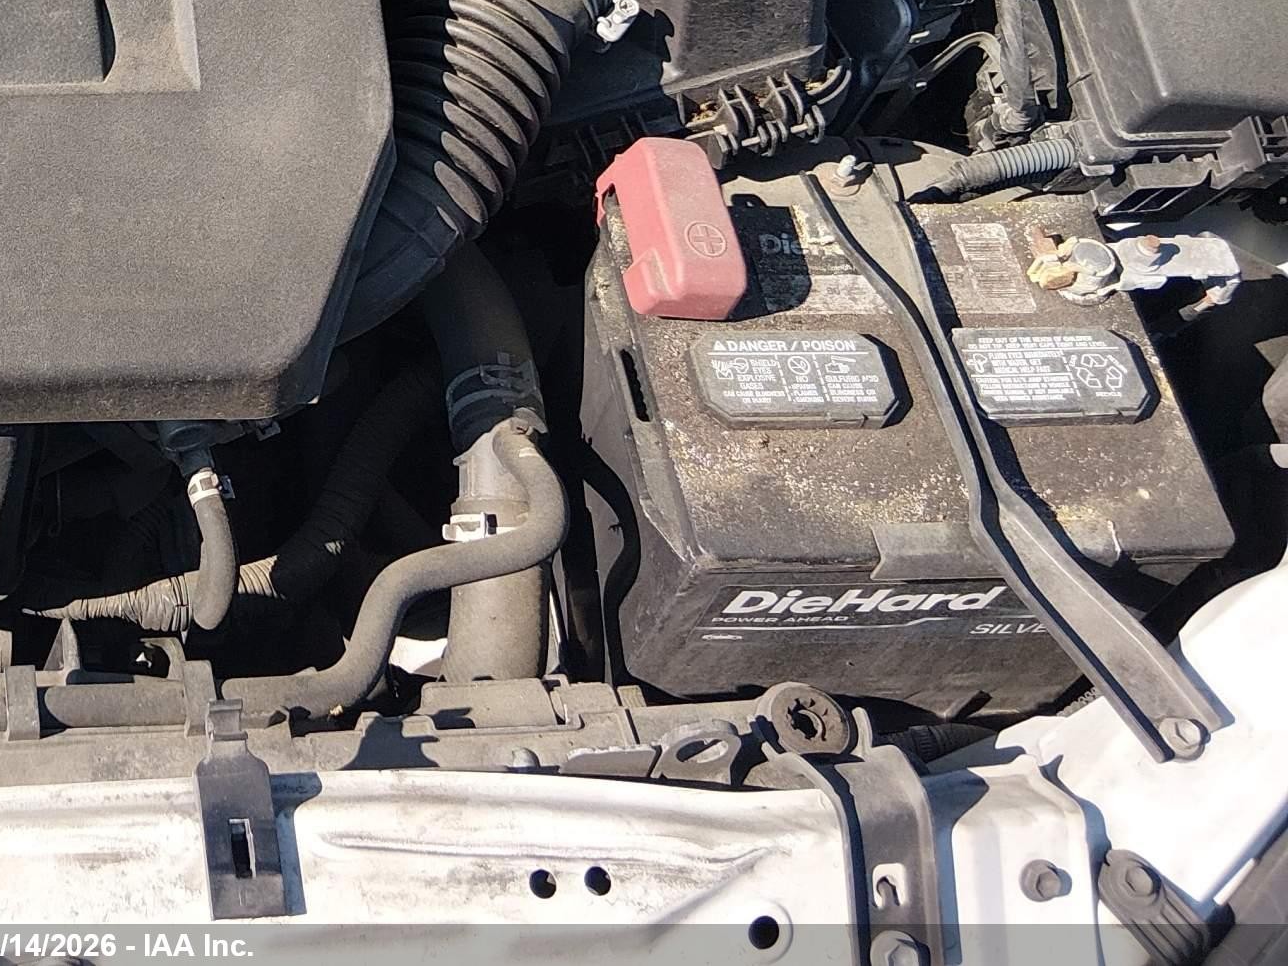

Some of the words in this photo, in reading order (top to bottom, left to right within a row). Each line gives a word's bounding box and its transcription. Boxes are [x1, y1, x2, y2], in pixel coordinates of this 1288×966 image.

[726, 340, 787, 352] DANGER
[790, 340, 797, 351] /
[802, 339, 856, 351] POISON
[721, 586, 1009, 614] DieHard
[784, 615, 850, 623] AHEAD
[969, 623, 1049, 635] SILVE
